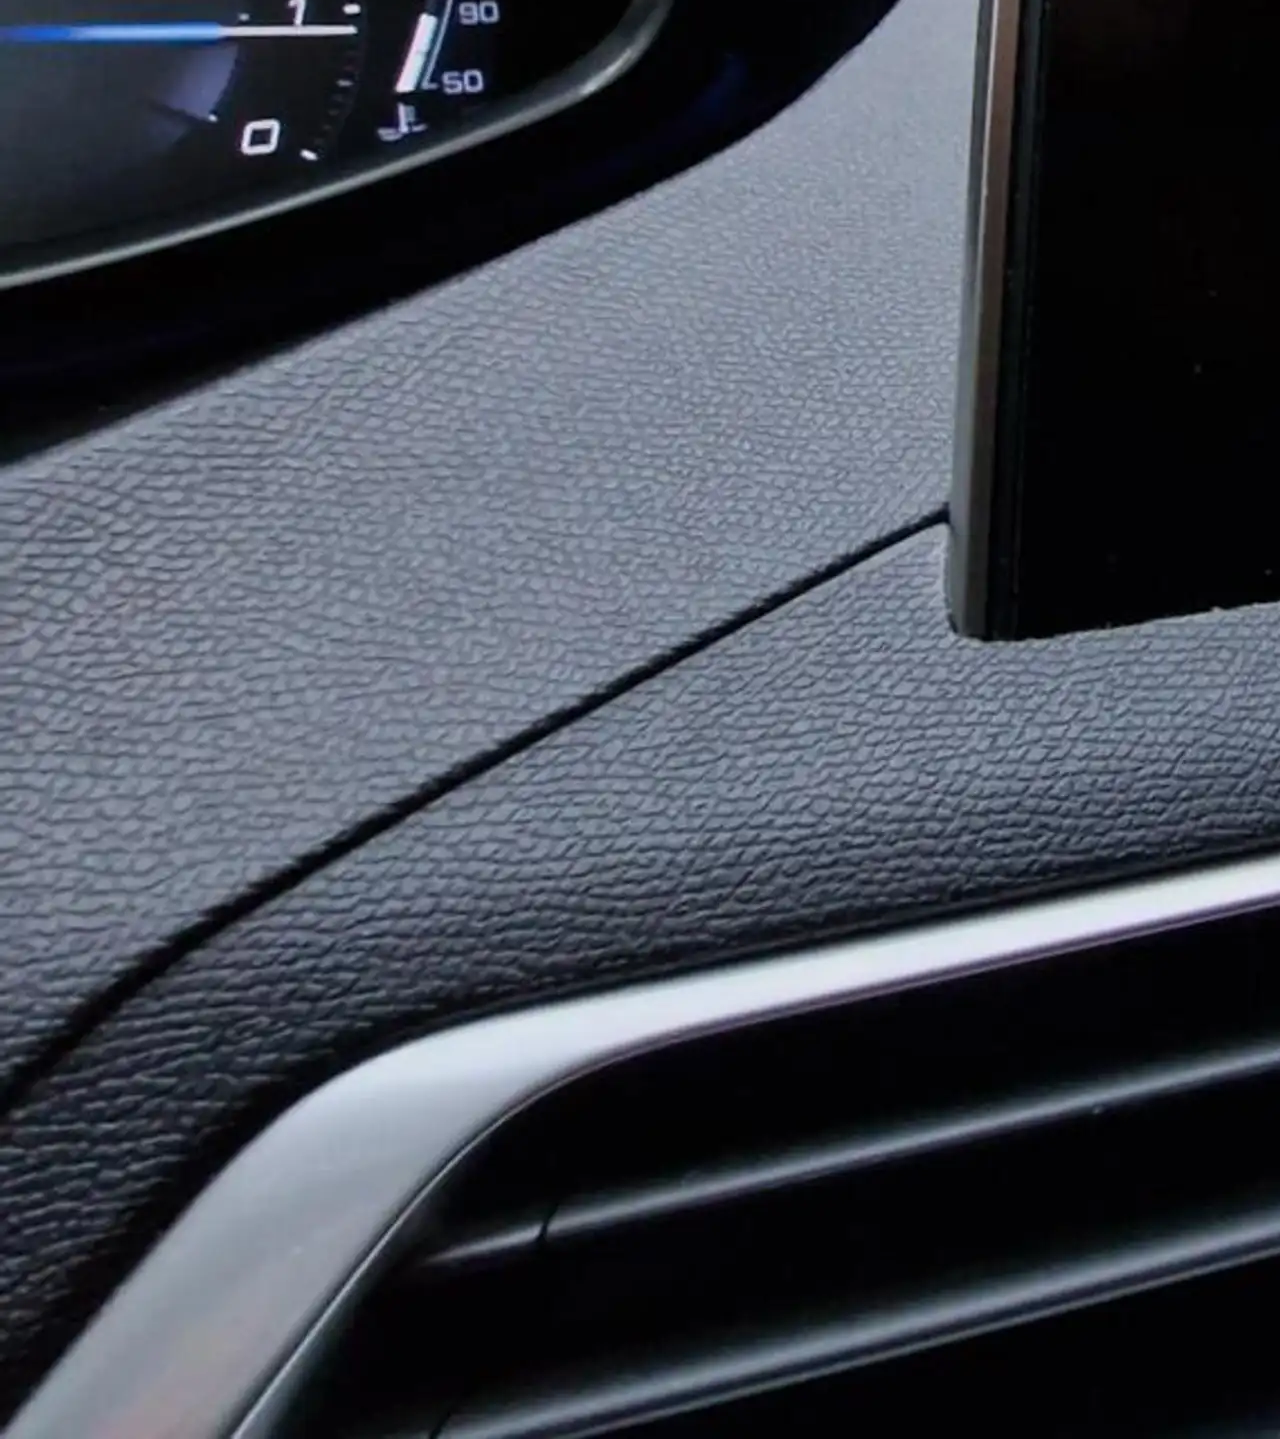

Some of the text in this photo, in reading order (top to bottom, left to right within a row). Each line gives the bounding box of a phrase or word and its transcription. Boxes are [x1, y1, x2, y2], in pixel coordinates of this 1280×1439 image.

[458, 0, 501, 26] 90
[441, 69, 485, 95] 50
[240, 119, 281, 155] 0
